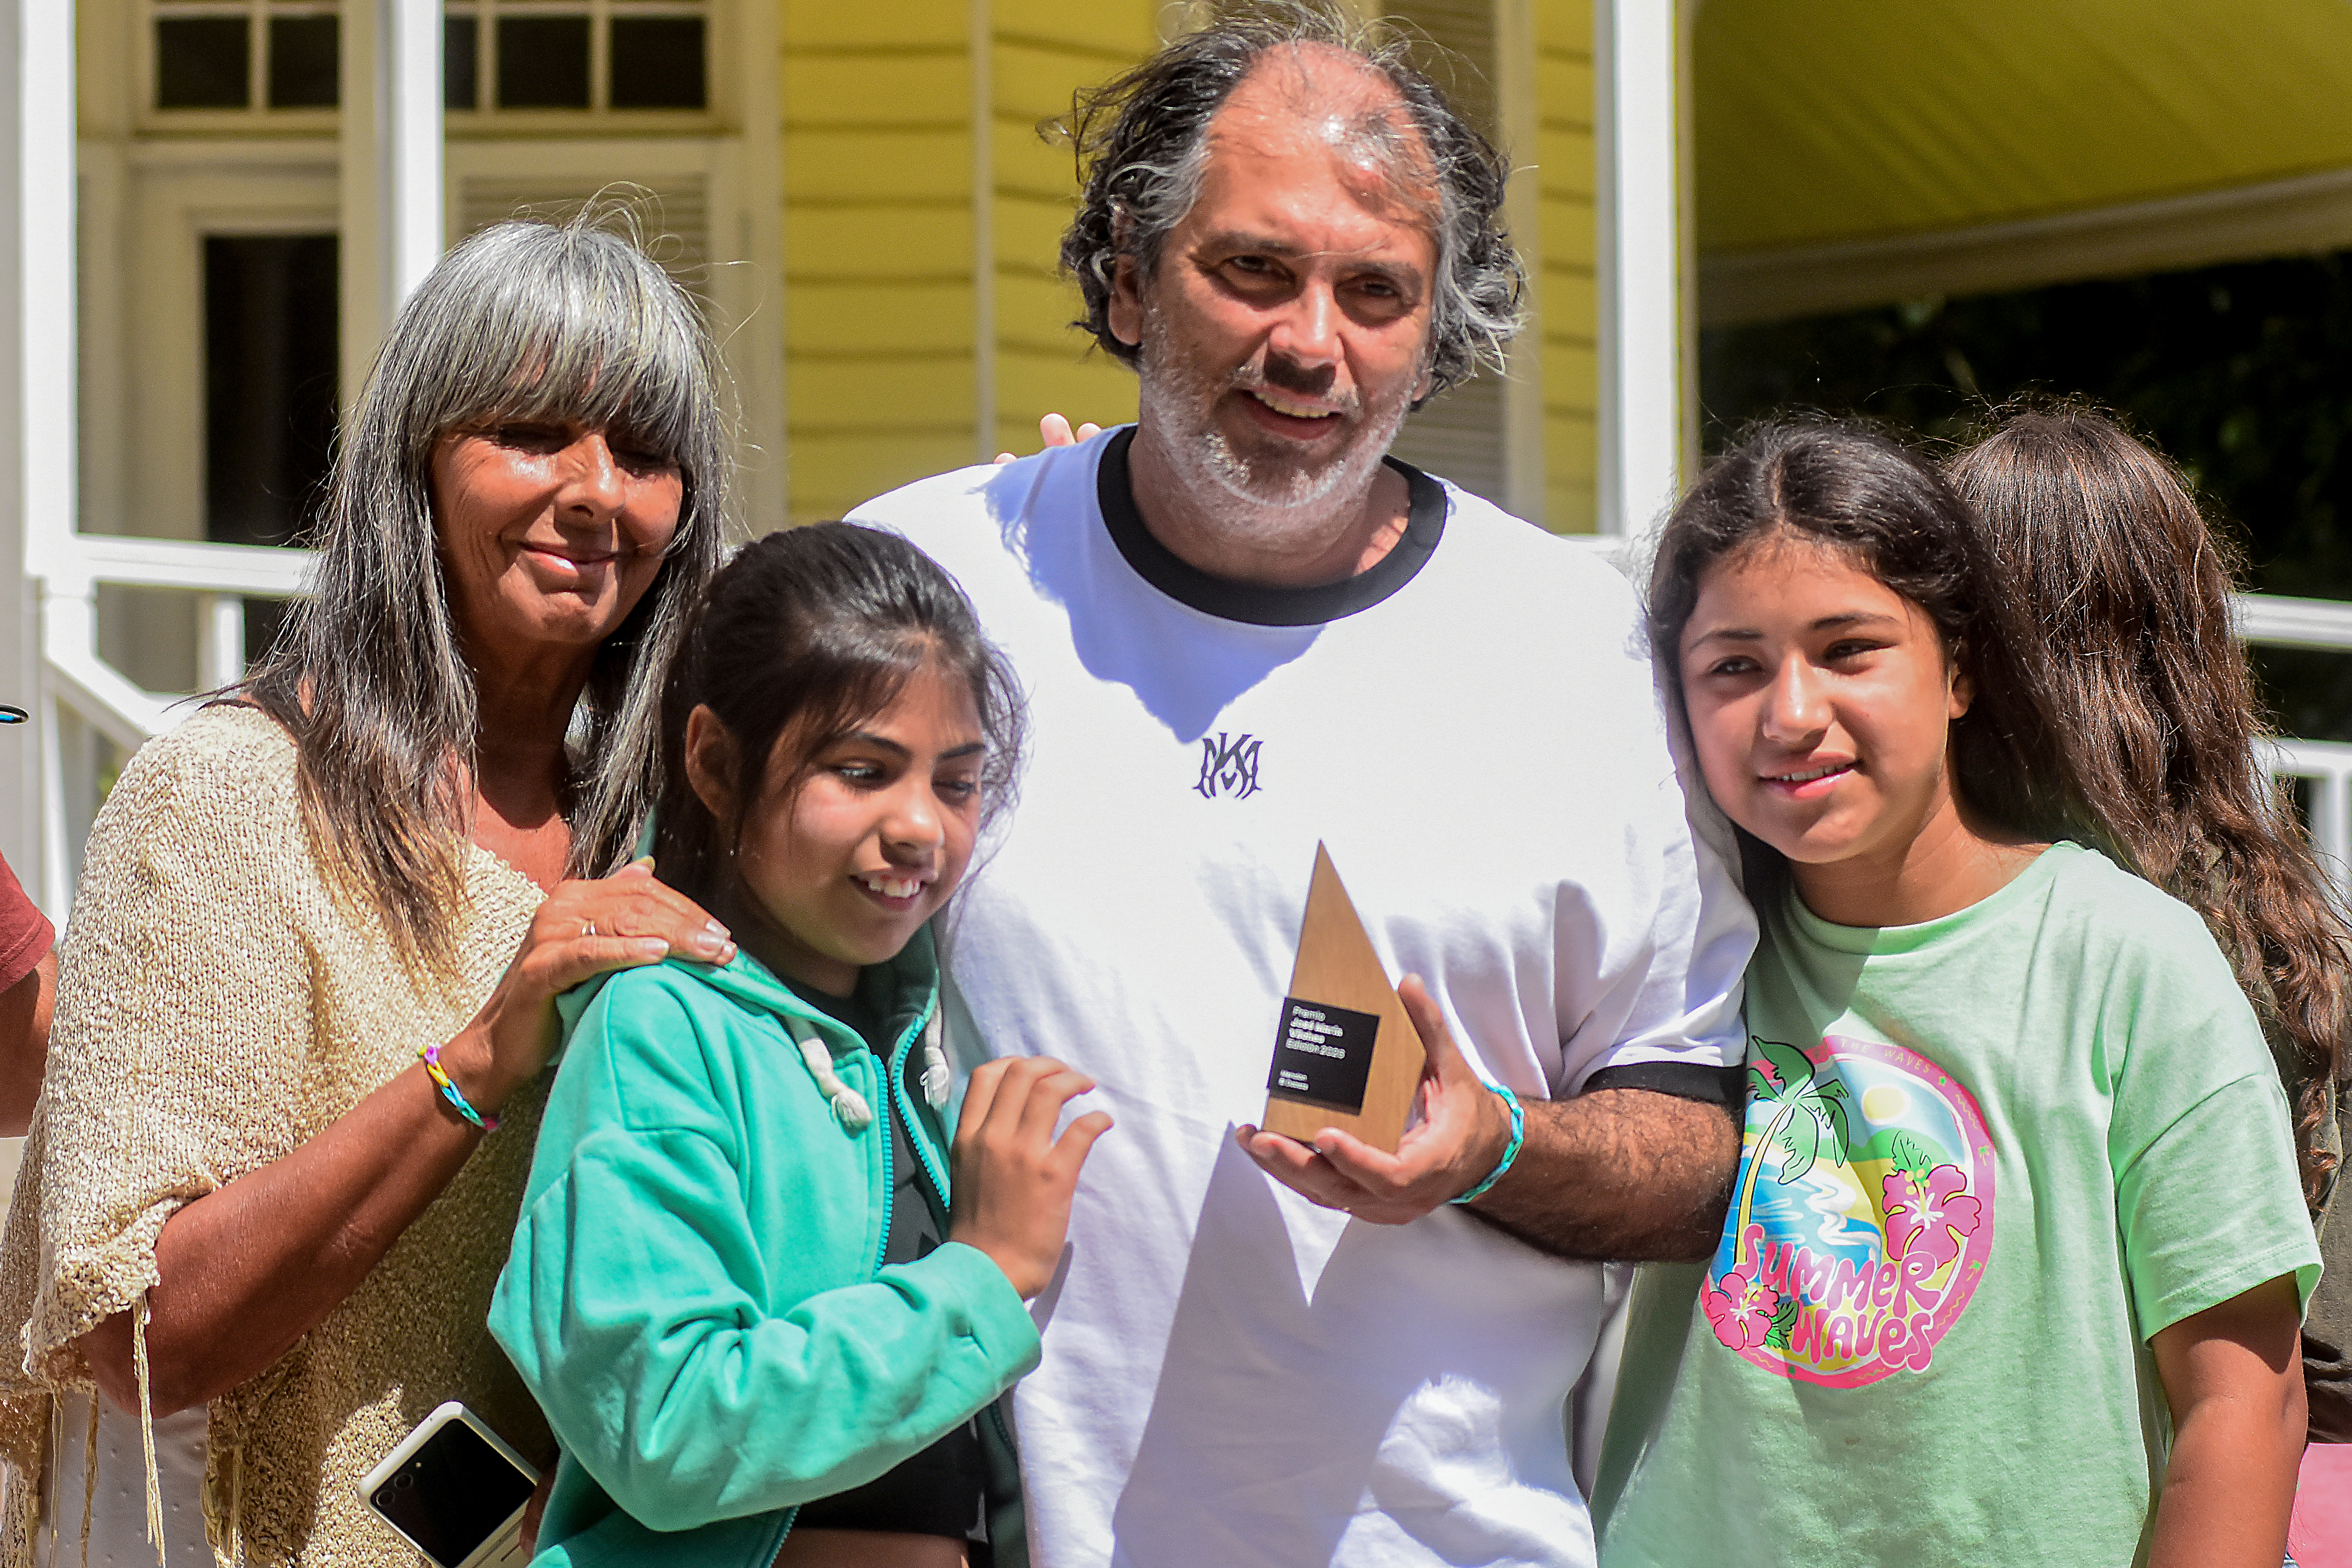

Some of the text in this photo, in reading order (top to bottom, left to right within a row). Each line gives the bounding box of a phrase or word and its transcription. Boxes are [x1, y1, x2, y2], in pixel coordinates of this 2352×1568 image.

[1292, 1006, 1325, 1021] Premio
[1841, 1038, 1931, 1073] THE WAVES
